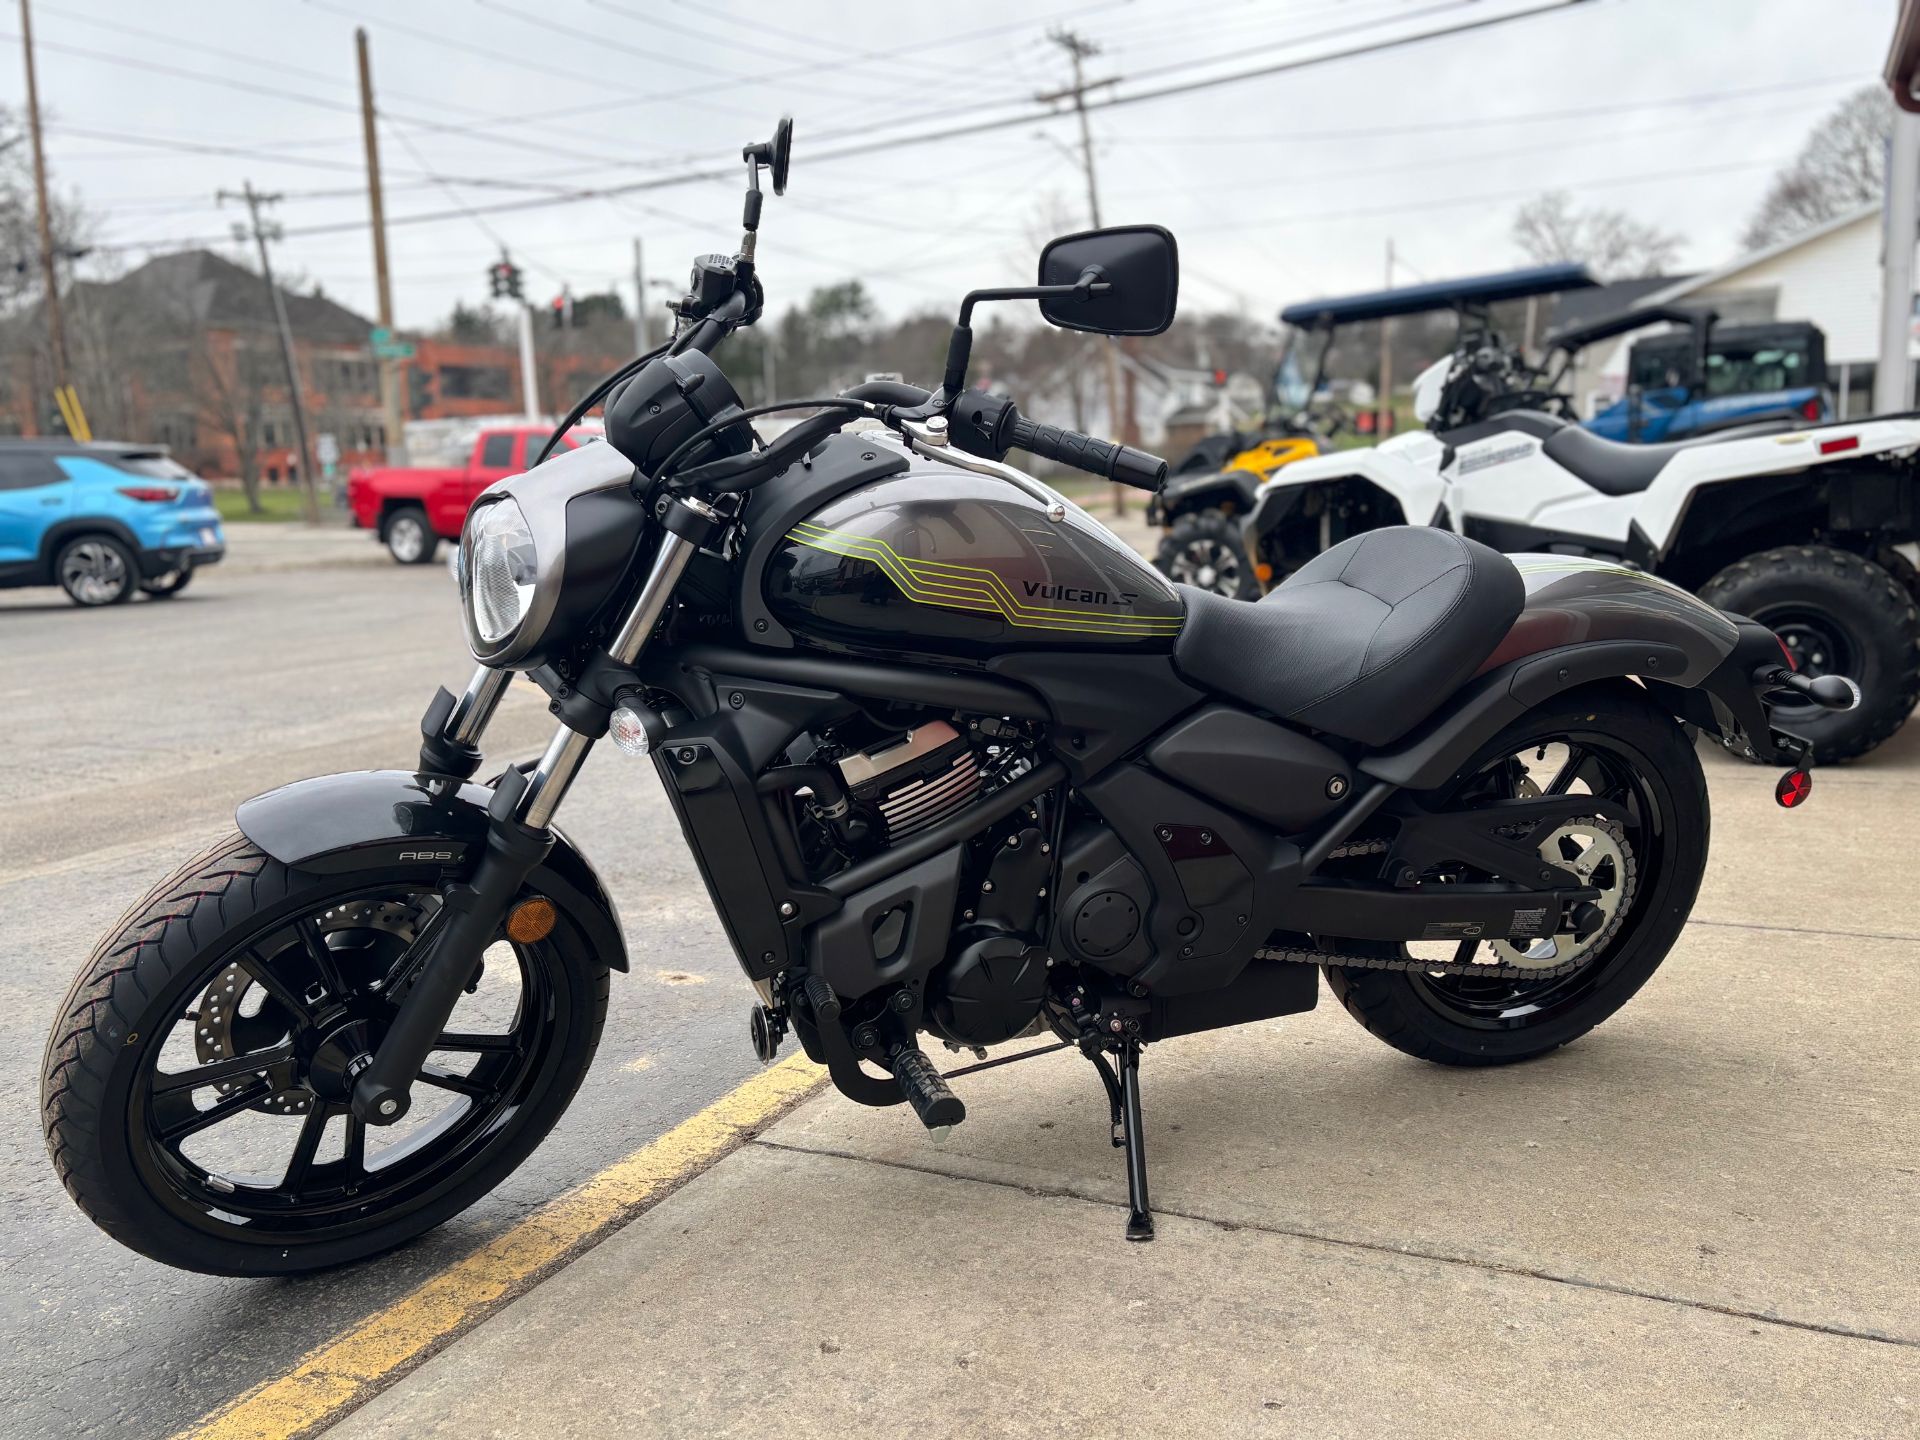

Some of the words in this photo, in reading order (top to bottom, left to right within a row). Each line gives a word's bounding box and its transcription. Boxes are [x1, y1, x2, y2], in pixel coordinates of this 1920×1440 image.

[1023, 580, 1108, 604] Vulcan
[1112, 592, 1138, 605] S
[399, 851, 452, 860] ABS
